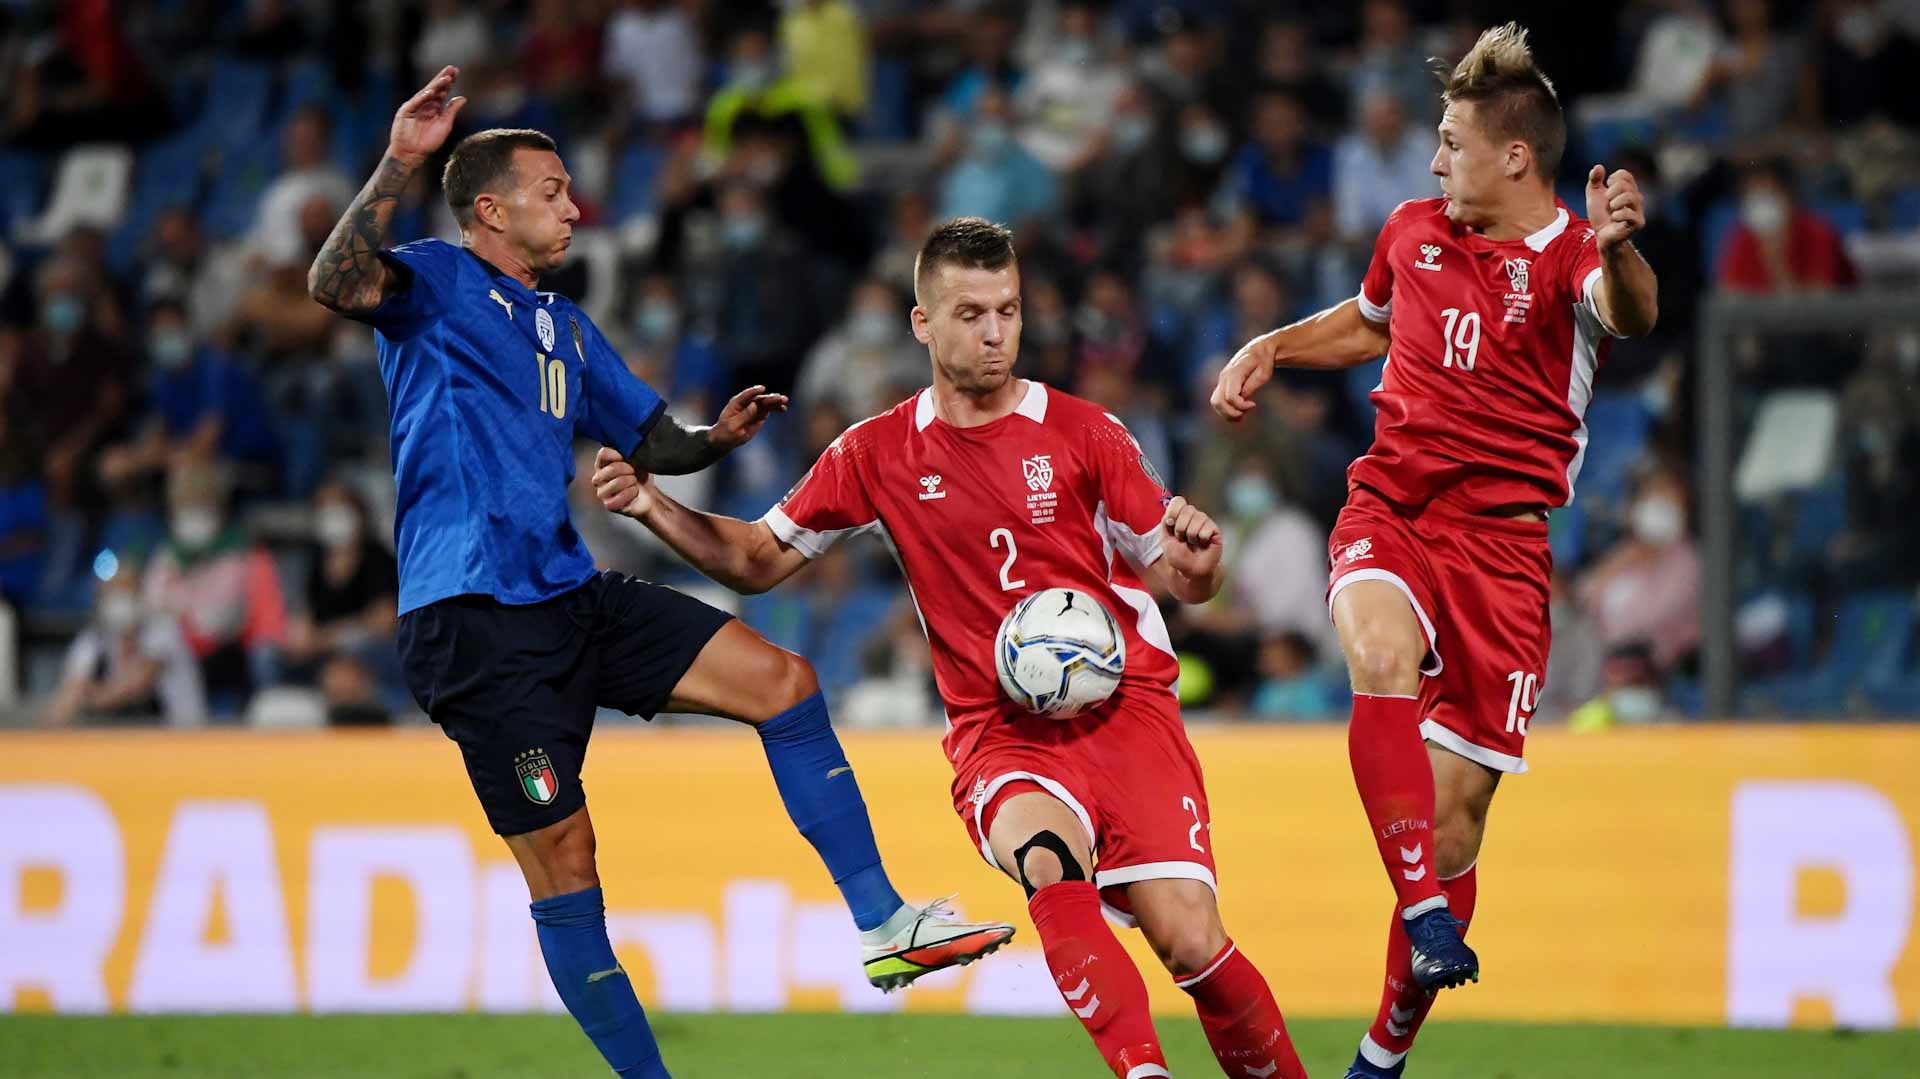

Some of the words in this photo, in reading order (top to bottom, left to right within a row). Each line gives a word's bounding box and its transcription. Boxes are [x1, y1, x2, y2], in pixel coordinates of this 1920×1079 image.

[1440, 308, 1480, 371] 19
[536, 353, 566, 419] 10
[1027, 492, 1057, 502] LIETUVA
[990, 528, 1025, 591] 2
[1505, 671, 1542, 737] 19
[519, 758, 547, 775] ITALIA
[1182, 795, 1205, 854] 2
[1382, 819, 1428, 839] LIETUVA
